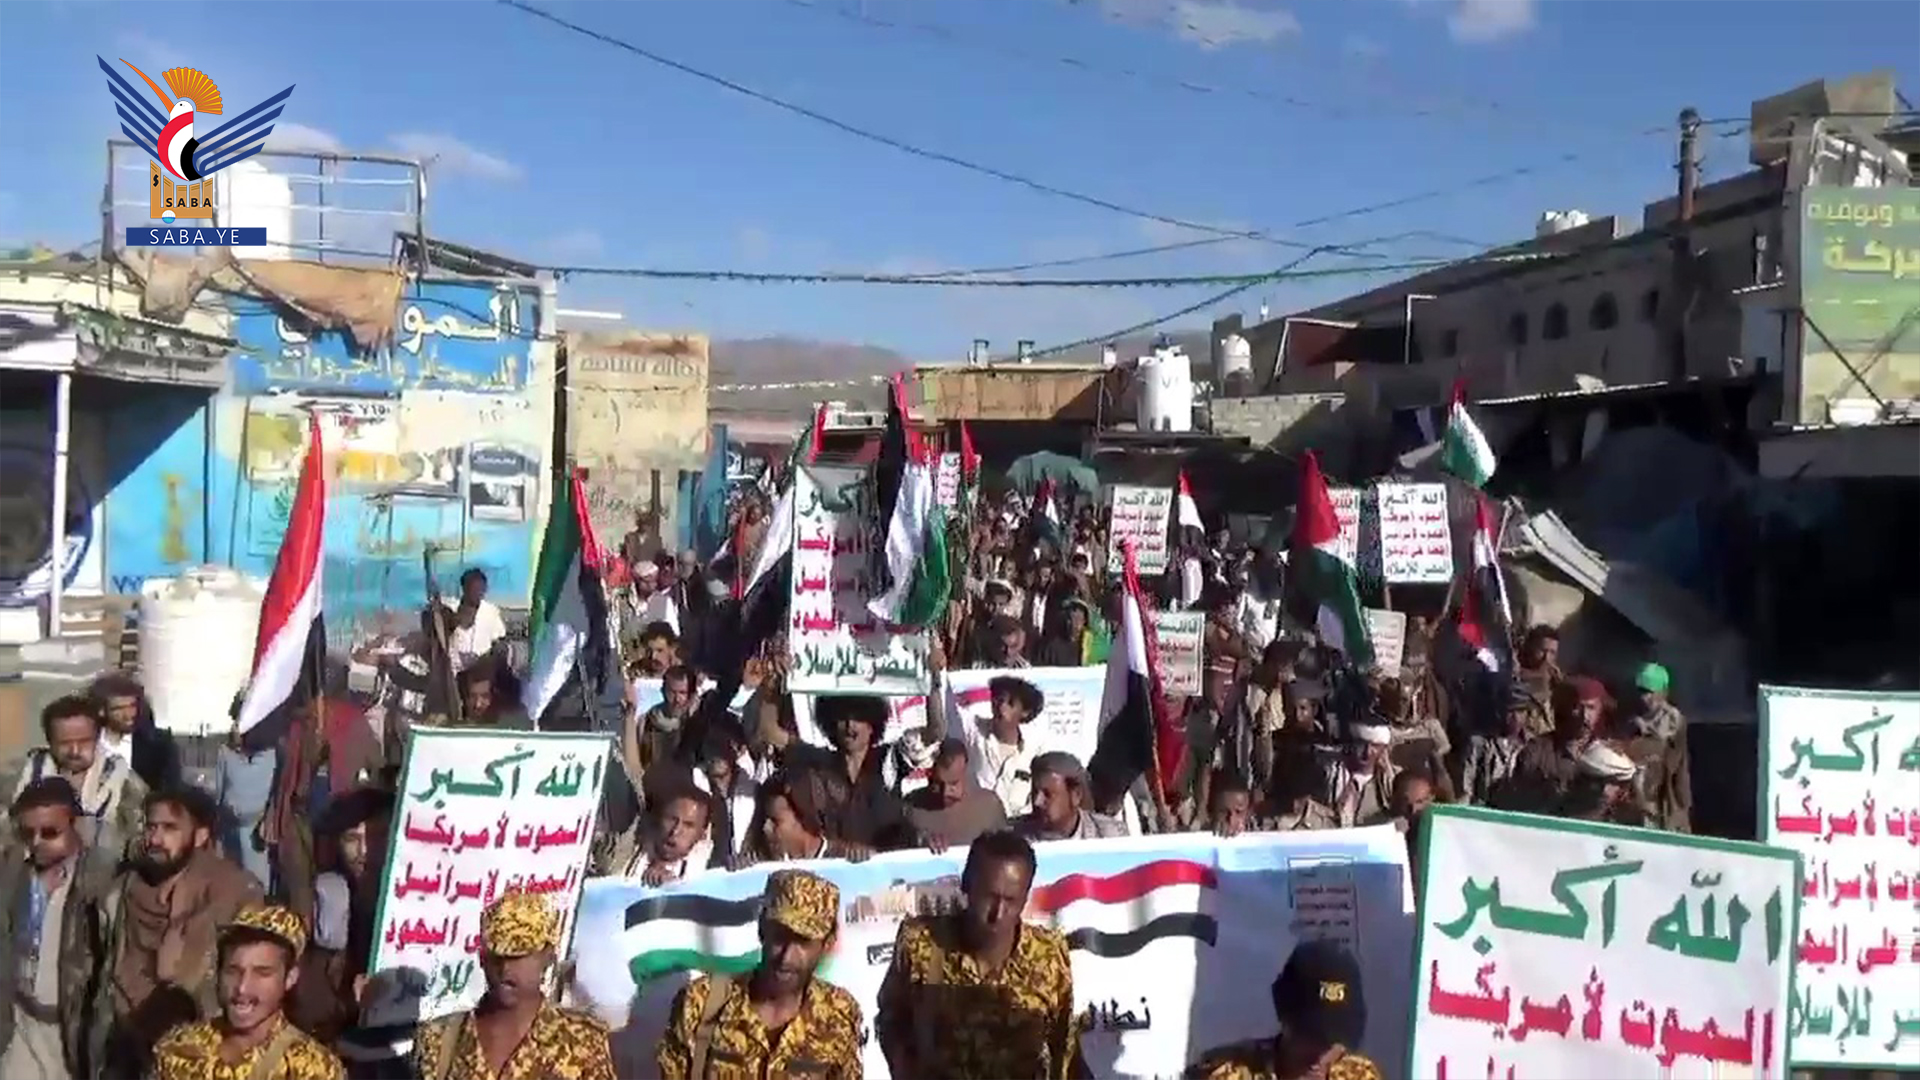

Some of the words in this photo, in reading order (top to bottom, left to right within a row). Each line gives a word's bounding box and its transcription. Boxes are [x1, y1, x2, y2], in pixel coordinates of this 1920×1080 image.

[409, 742, 536, 810] أكبر
[535, 752, 603, 799] الله
[404, 810, 509, 853] لأمريكا
[515, 808, 592, 854] الموت
[1775, 790, 1876, 845] لأمريكا
[1433, 845, 1644, 956] أكبر
[1646, 868, 1782, 966] الله
[385, 915, 460, 954] اليهود
[1428, 959, 1606, 1042] لأمريكا
[1619, 998, 1775, 1067] الموت
